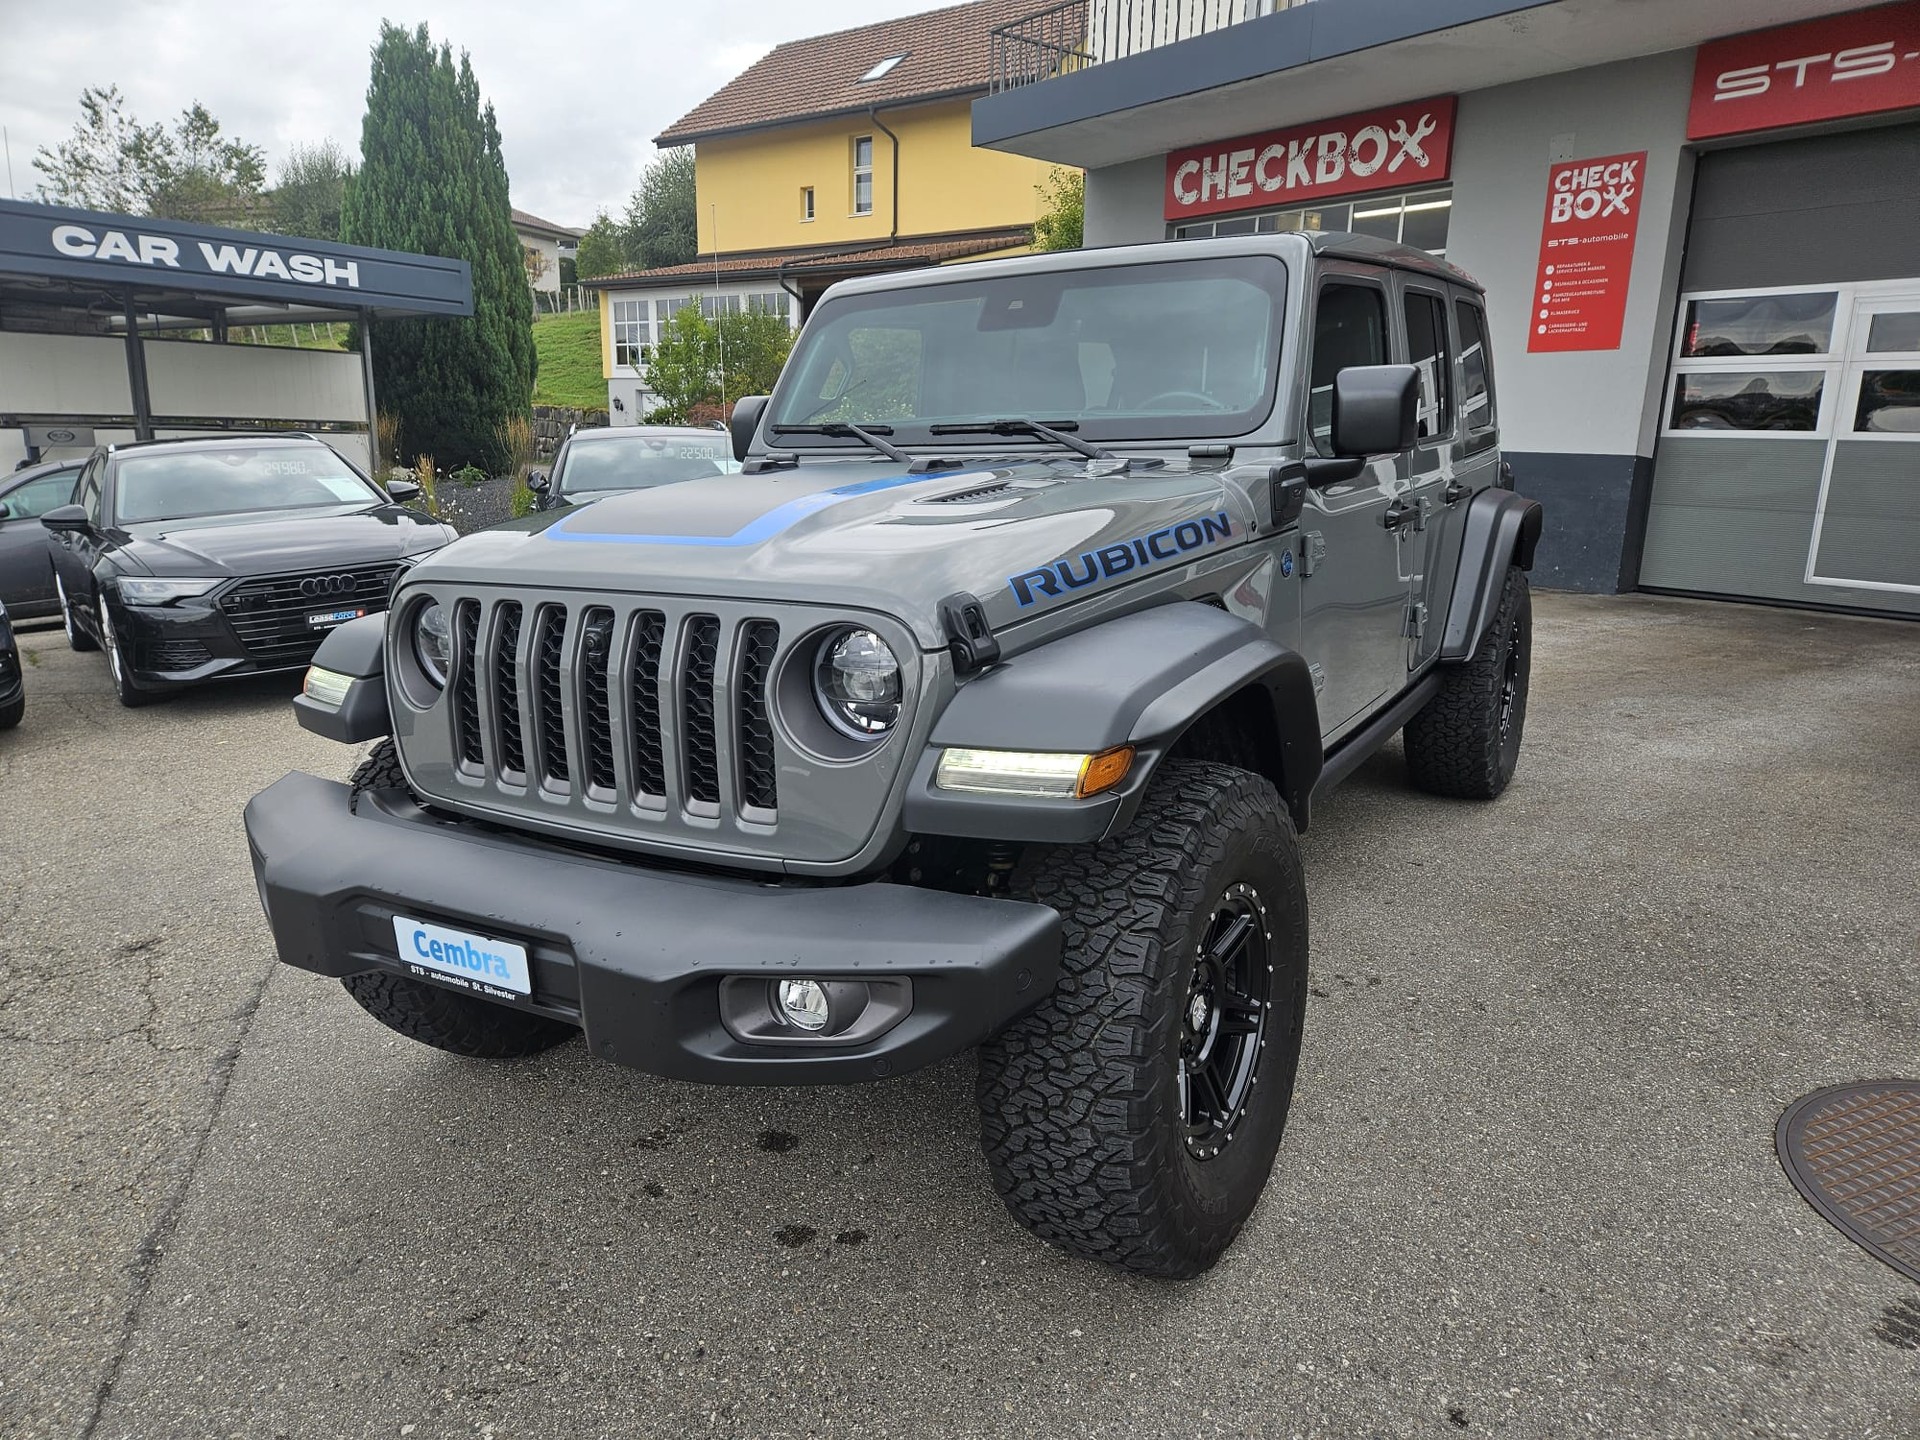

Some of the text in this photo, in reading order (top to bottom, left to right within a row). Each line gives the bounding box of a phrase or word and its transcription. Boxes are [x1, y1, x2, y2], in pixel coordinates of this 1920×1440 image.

[1554, 160, 1639, 192] CHECK
[52, 225, 359, 288] CAR WASH
[1547, 231, 1629, 248] STS-automobile
[1008, 512, 1231, 608] RUBICON
[413, 930, 511, 979] Cembra
[410, 965, 425, 976] STS
[431, 971, 469, 988] automobile
[472, 981, 483, 992] St.
[484, 985, 516, 1001] Silvester
